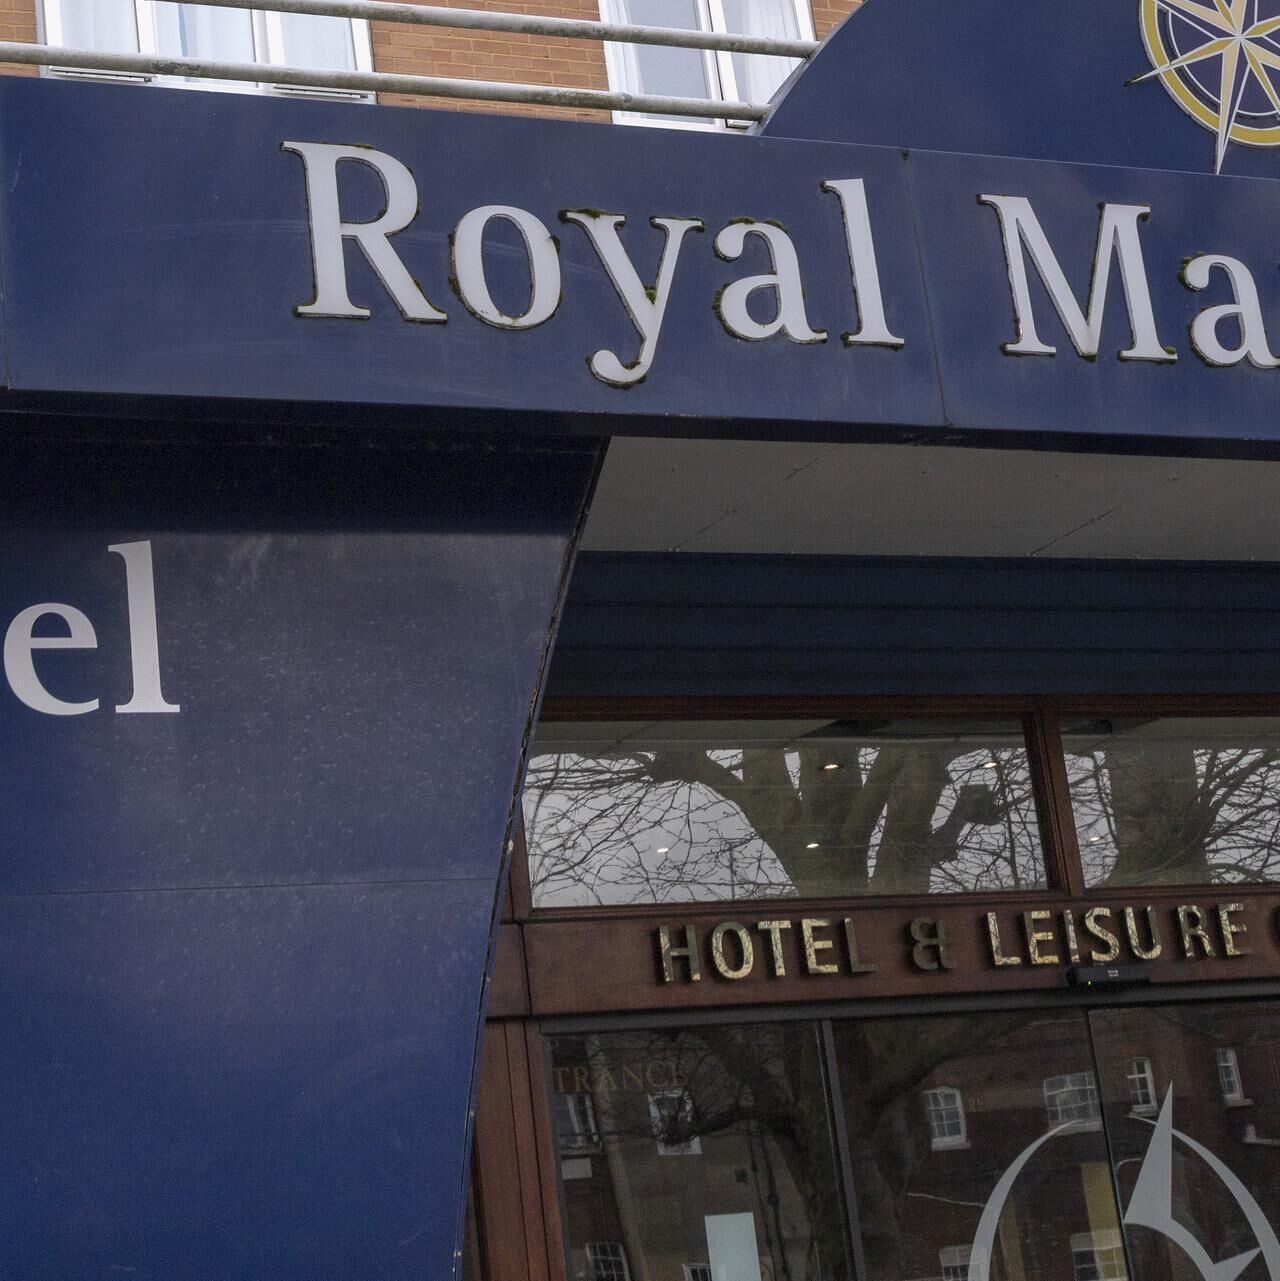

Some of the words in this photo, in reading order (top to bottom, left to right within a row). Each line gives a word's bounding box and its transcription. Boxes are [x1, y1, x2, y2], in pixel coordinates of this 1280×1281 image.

[281, 140, 906, 389] Royal
[657, 917, 878, 983] HOTEL
[986, 902, 1254, 968] LEISURE
